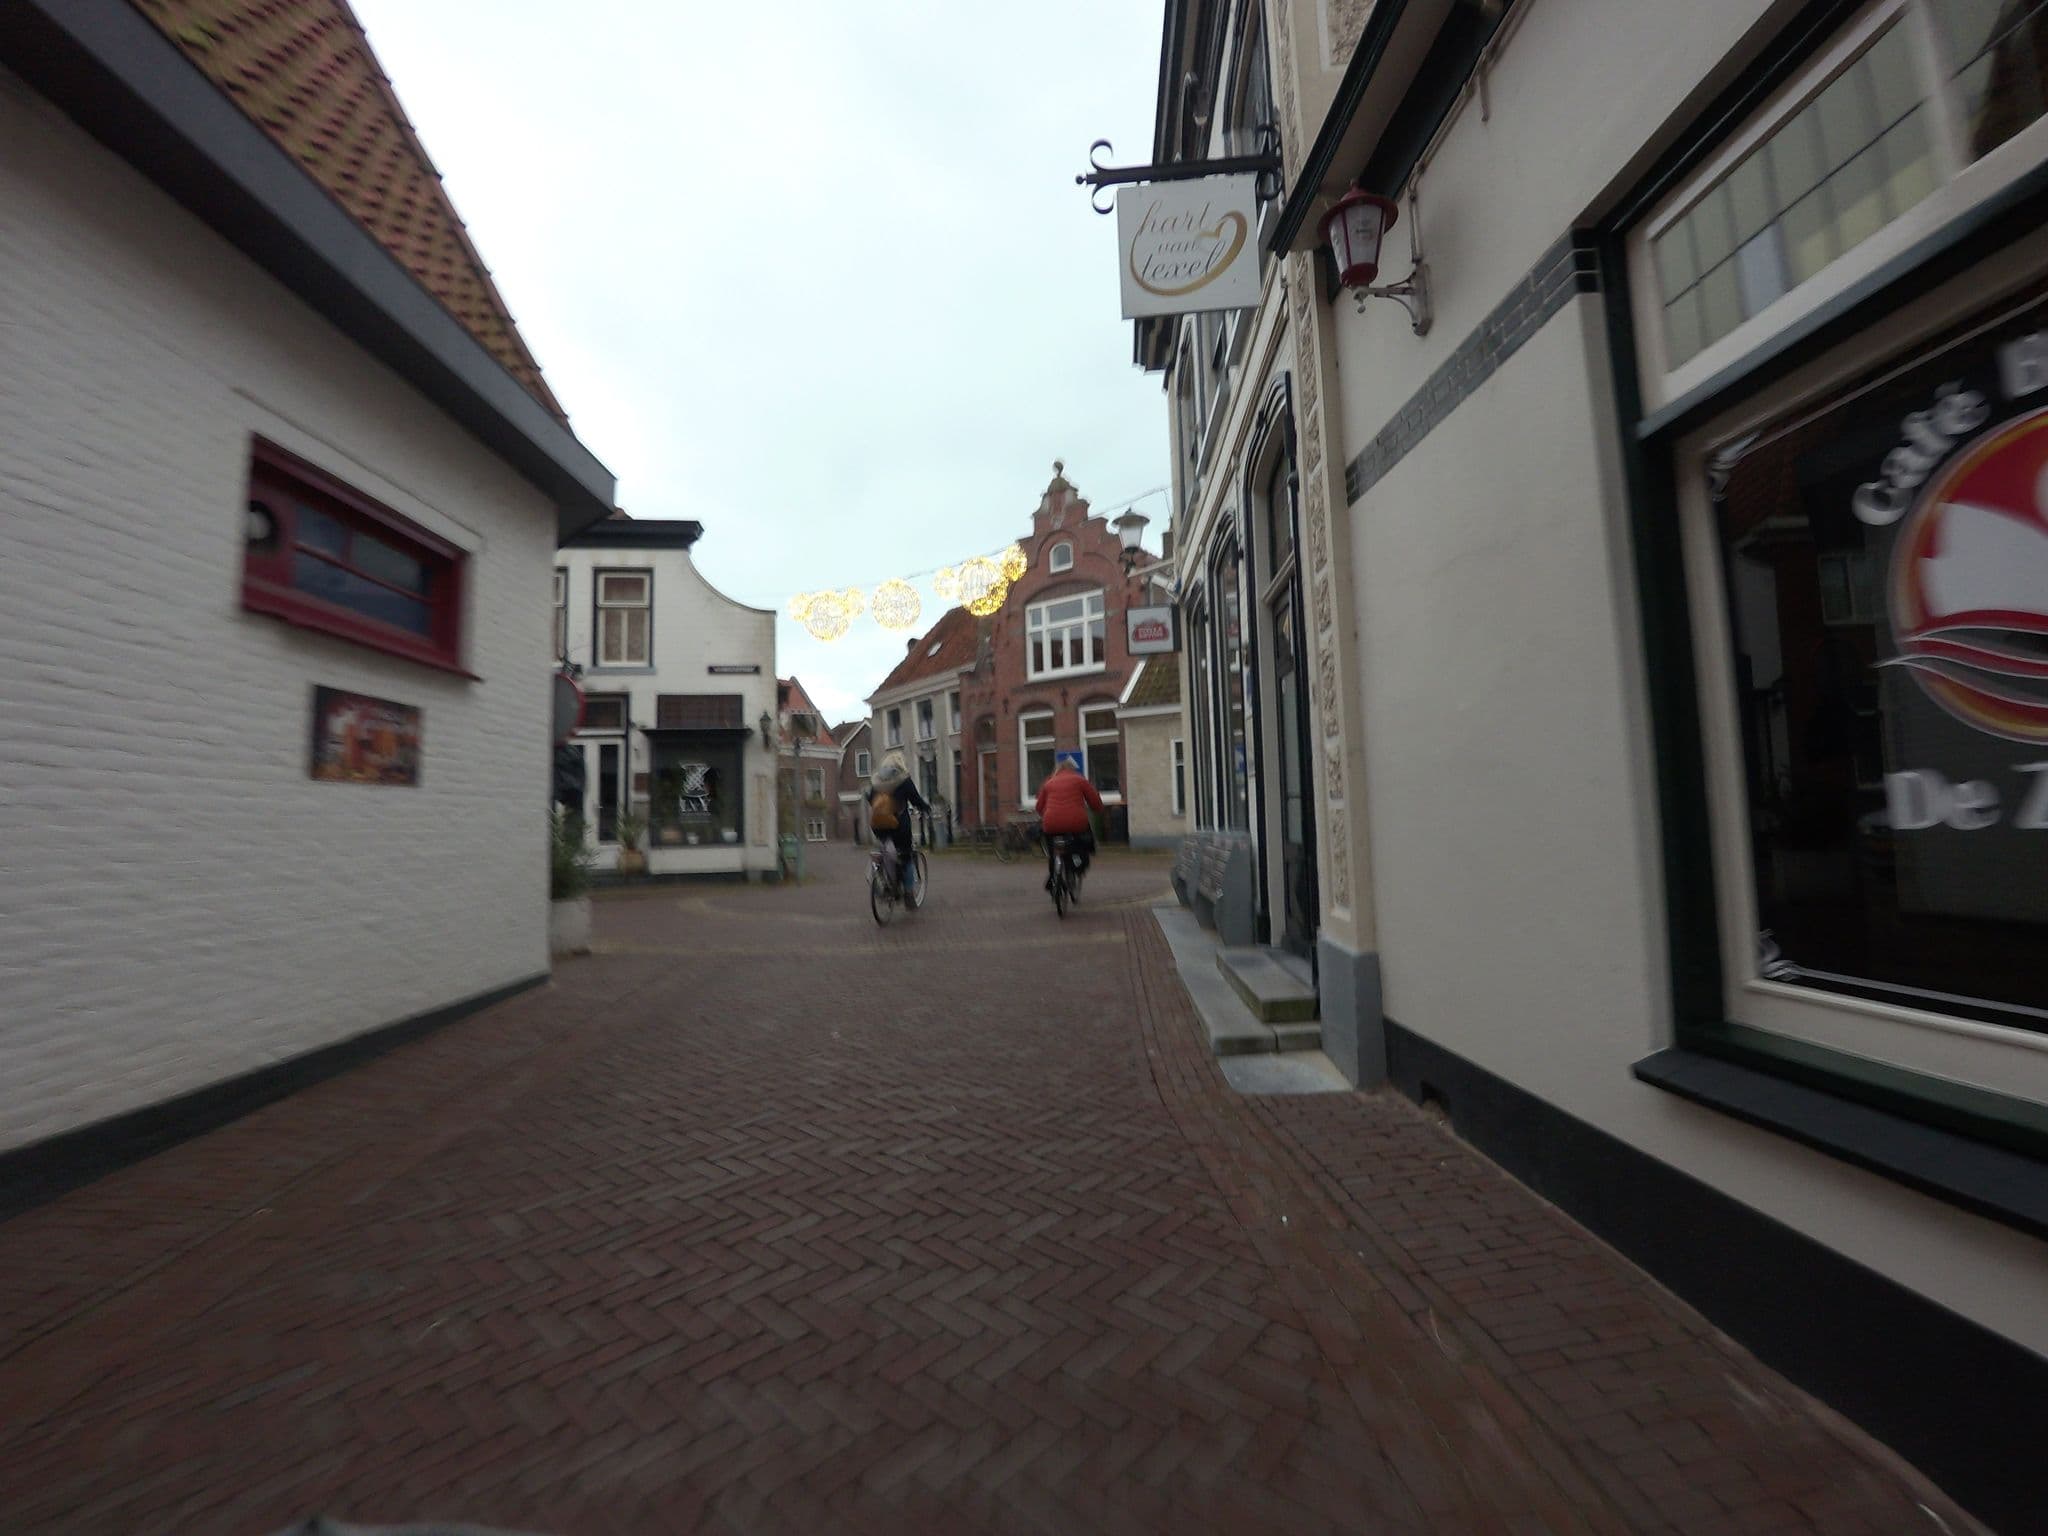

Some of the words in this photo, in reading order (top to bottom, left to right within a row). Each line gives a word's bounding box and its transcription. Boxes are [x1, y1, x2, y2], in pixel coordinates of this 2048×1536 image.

[1139, 199, 1213, 234] hart
[1141, 240, 1226, 280] texel
[1157, 240, 1201, 254] van
[1884, 769, 2002, 830] De
